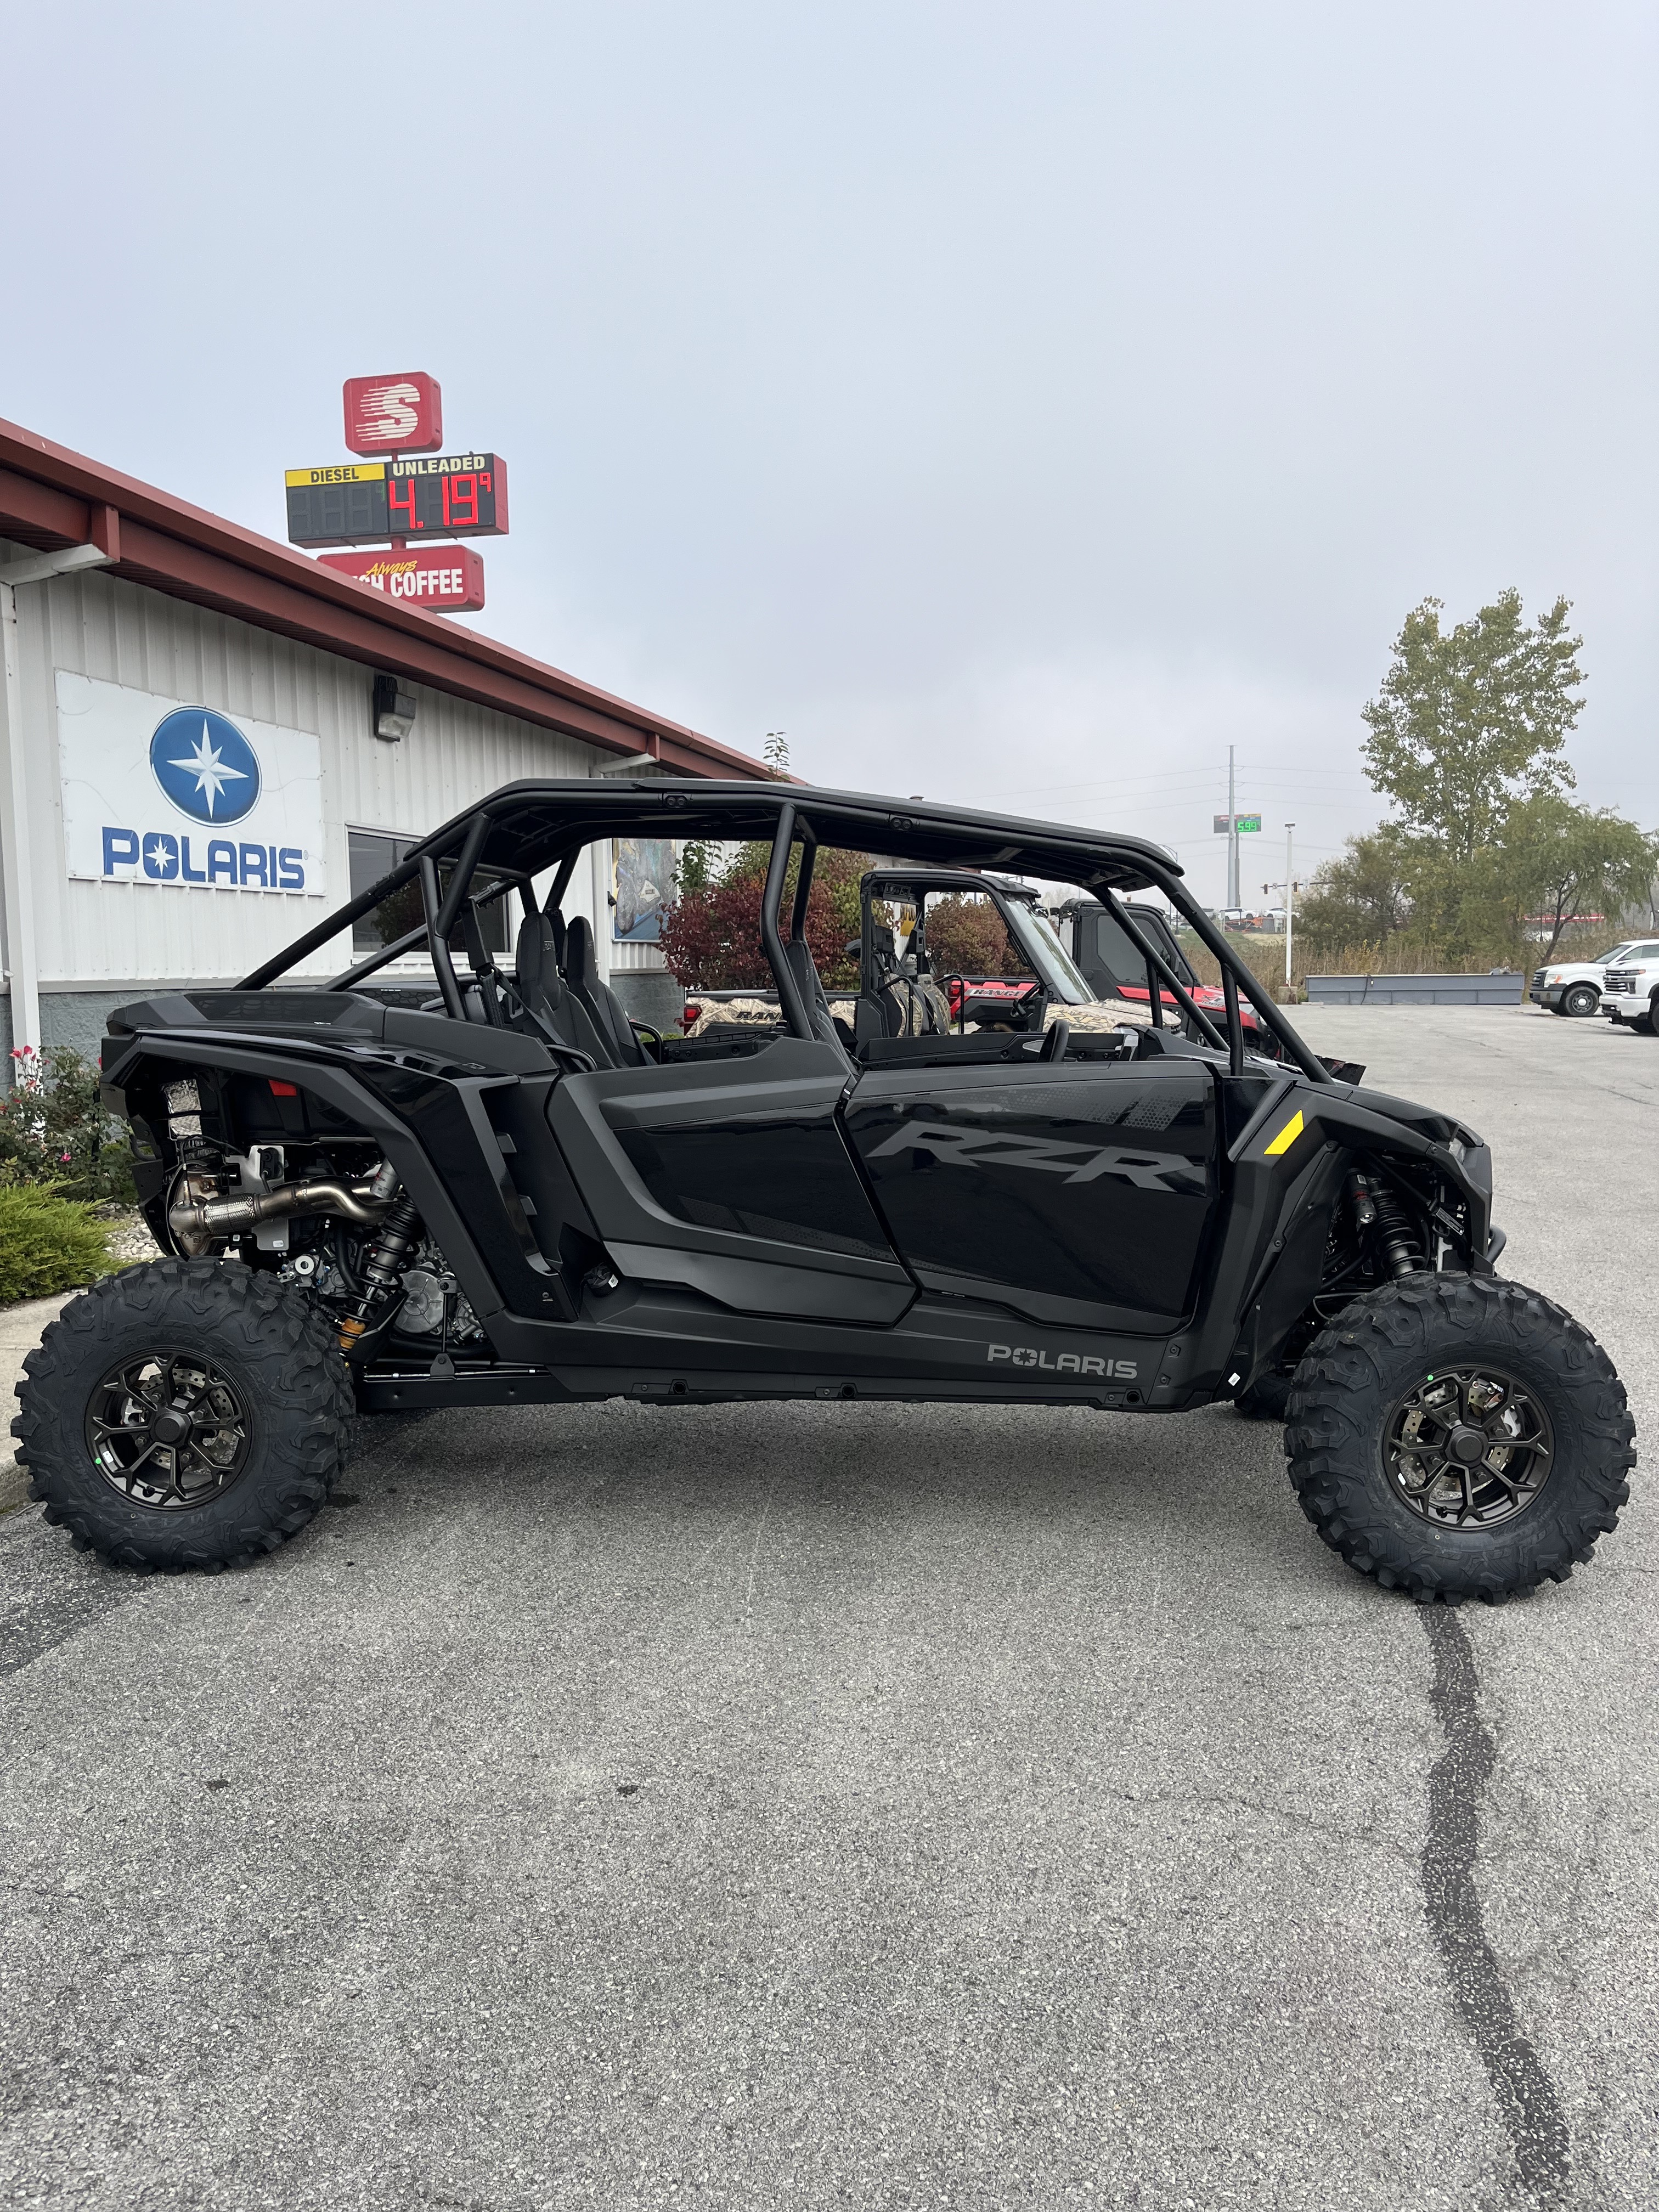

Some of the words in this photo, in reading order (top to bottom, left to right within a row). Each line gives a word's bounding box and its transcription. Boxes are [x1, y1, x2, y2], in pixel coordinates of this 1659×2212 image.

[311, 468, 359, 483] DIESEL
[392, 455, 486, 477] UNLEADED
[366, 560, 418, 578] Always
[390, 568, 464, 598] COFFEE
[102, 826, 305, 889] POLARIS
[735, 1011, 783, 1020] RAN
[864, 1120, 1196, 1193] RZR
[987, 1344, 1137, 1379] POLARIS
